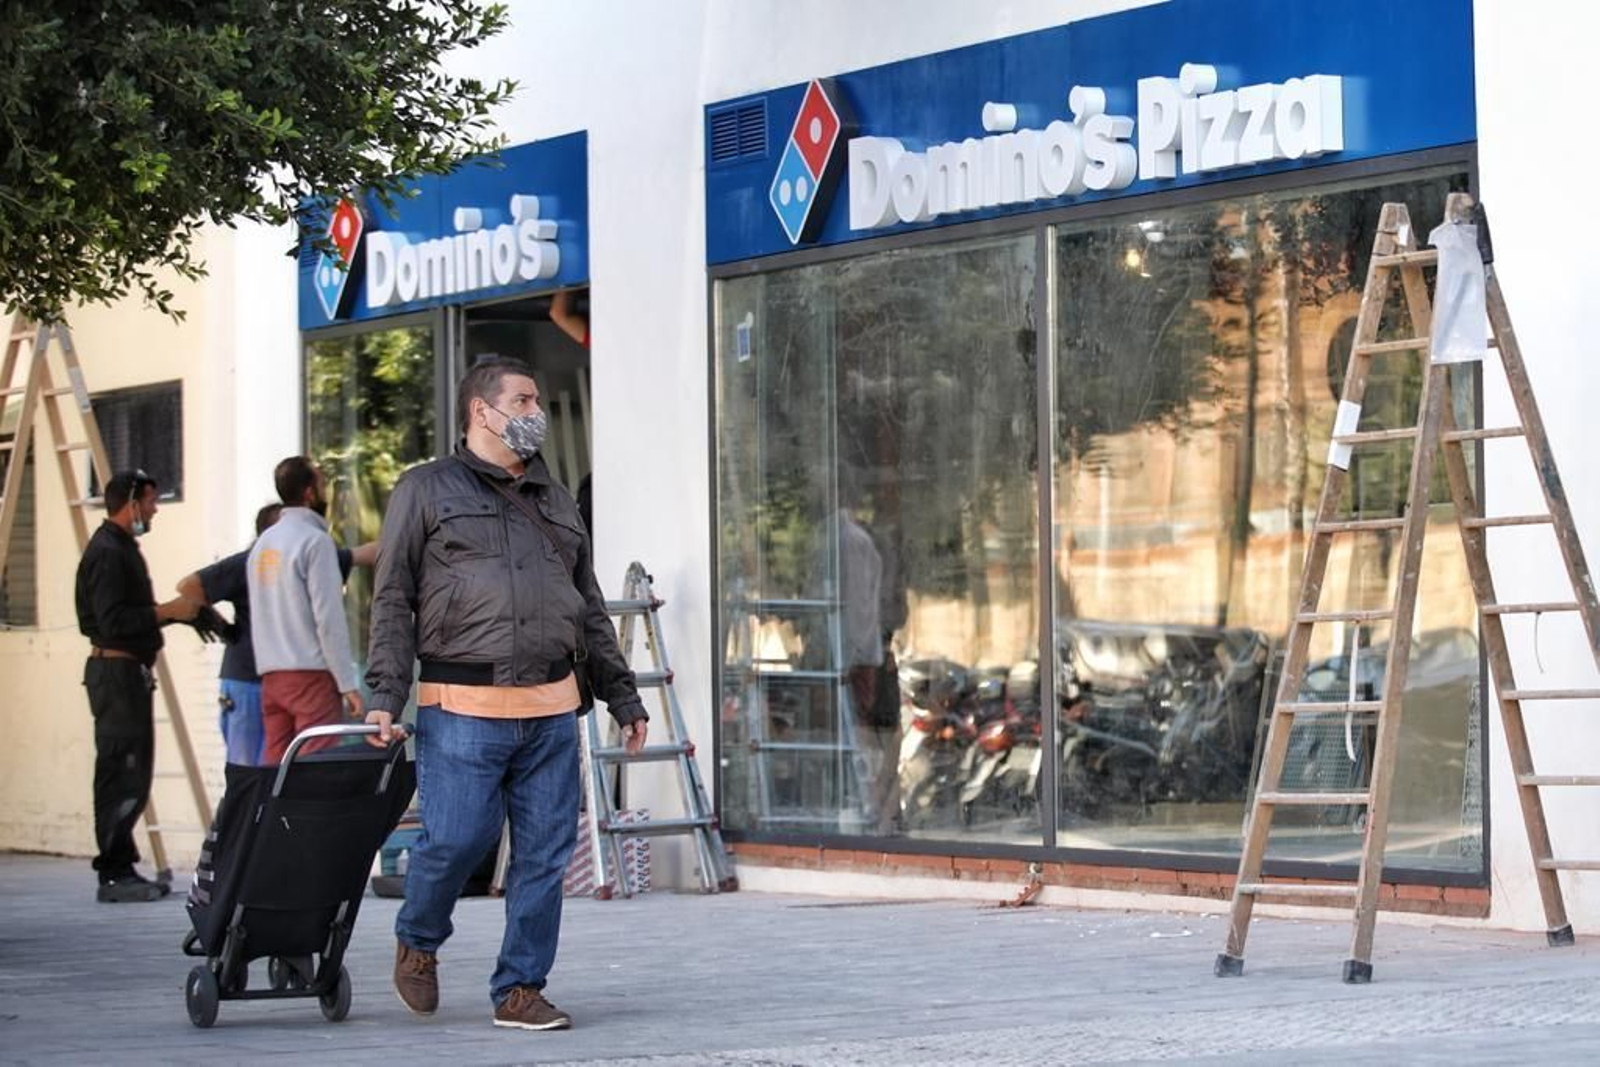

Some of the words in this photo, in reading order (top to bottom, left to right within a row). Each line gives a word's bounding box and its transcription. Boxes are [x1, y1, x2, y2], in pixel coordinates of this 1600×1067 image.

[848, 85, 1136, 231] Domino's
[1137, 63, 1344, 180] Pizza
[366, 194, 560, 308] Domino's
